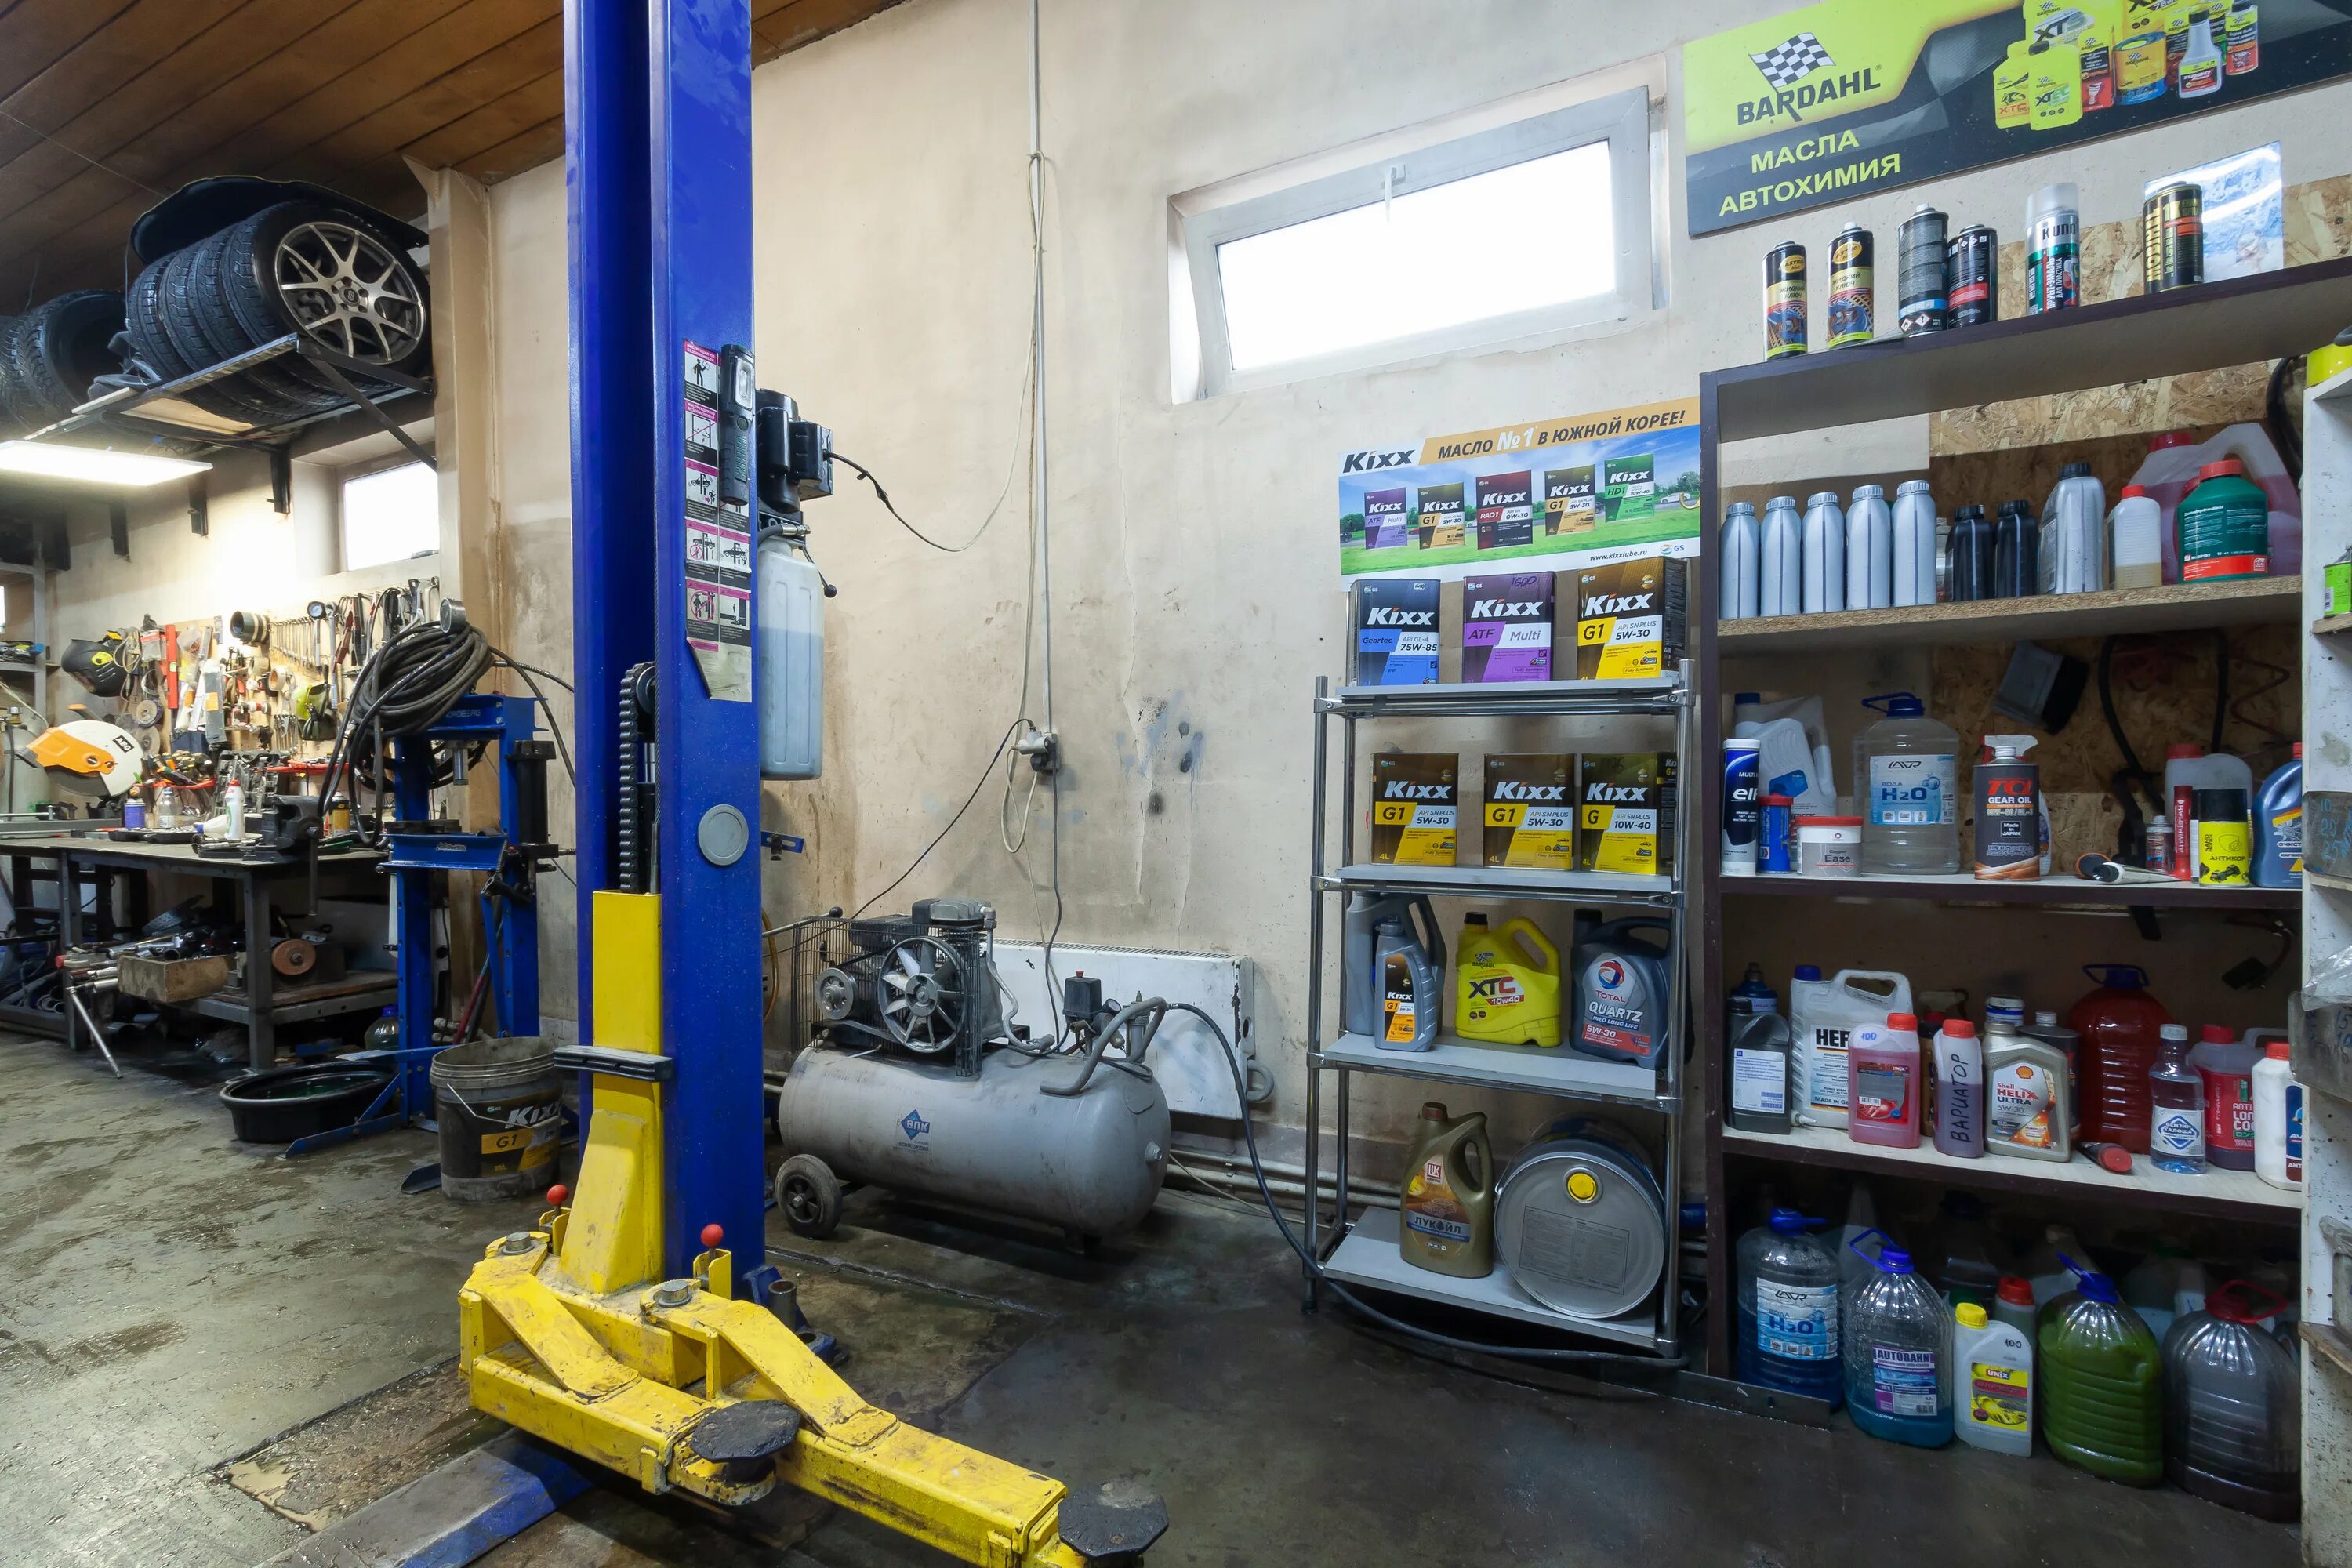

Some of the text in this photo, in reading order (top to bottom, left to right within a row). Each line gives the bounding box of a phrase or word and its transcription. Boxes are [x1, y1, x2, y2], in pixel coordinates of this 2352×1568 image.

[1737, 67, 1881, 125] BARDAHL
[1751, 130, 1860, 174] МАСЛА
[1719, 153, 1900, 216] АВТОХИМИЯ
[1835, 281, 1856, 291] КЛЮЧ
[1437, 440, 1493, 459] МАСЛО
[1537, 432, 1548, 445] В
[1552, 416, 1622, 443] ЮЖНОЙ
[1625, 410, 1686, 432] КОРЕЕ!
[1342, 449, 1415, 474] Kixx
[1610, 470, 1649, 484] Kixx
[1549, 485, 1591, 497] Kixx
[1607, 487, 1625, 496] HD1
[1482, 492, 1526, 506] Kixx
[1549, 500, 1563, 510] G1
[1369, 503, 1403, 514] Kixx
[1423, 500, 1460, 513] Kixx
[1423, 516, 1435, 524] G1
[1590, 550, 1648, 561] www.kixxlube.ru
[1471, 598, 1543, 619] Kixx
[1584, 593, 1653, 616] Kixx
[1367, 607, 1435, 626] Kixx
[1468, 628, 1495, 640] ATF
[1510, 630, 1541, 641] Multi
[1583, 623, 1605, 641] G1
[1615, 629, 1650, 641] 5W-30
[1400, 643, 1437, 652] 75W-85
[1384, 781, 1452, 799] Kixx
[1494, 781, 1566, 800] Kixx
[1586, 782, 1648, 801] Kixx
[1882, 786, 1927, 801] H2O
[1383, 807, 1405, 821] G1
[1416, 816, 1450, 825] 5W-30
[1492, 808, 1516, 822] G1
[1588, 809, 1599, 825] G
[1527, 818, 1563, 827] 5W-30
[1614, 821, 1651, 830] 10W-40
[1824, 854, 1851, 862] Ease
[1468, 976, 1516, 999] XTC
[1387, 992, 1413, 1000] Kixx
[1491, 996, 1520, 1005] 10w40
[1595, 989, 1626, 1003] TOTAL
[1588, 1001, 1643, 1022] QUARTZ
[1586, 1025, 1617, 1038] 5W-30
[1950, 1054, 1973, 1143] ВАРИАТОР
[1997, 1088, 2038, 1100] HELIX
[1997, 1095, 2032, 1105] ULTRA
[1998, 1104, 2024, 1113] 5W-30
[906, 1120, 929, 1131] ВПК
[496, 1134, 518, 1149] G1
[1877, 1348, 1929, 1363] AUTOBAHN
